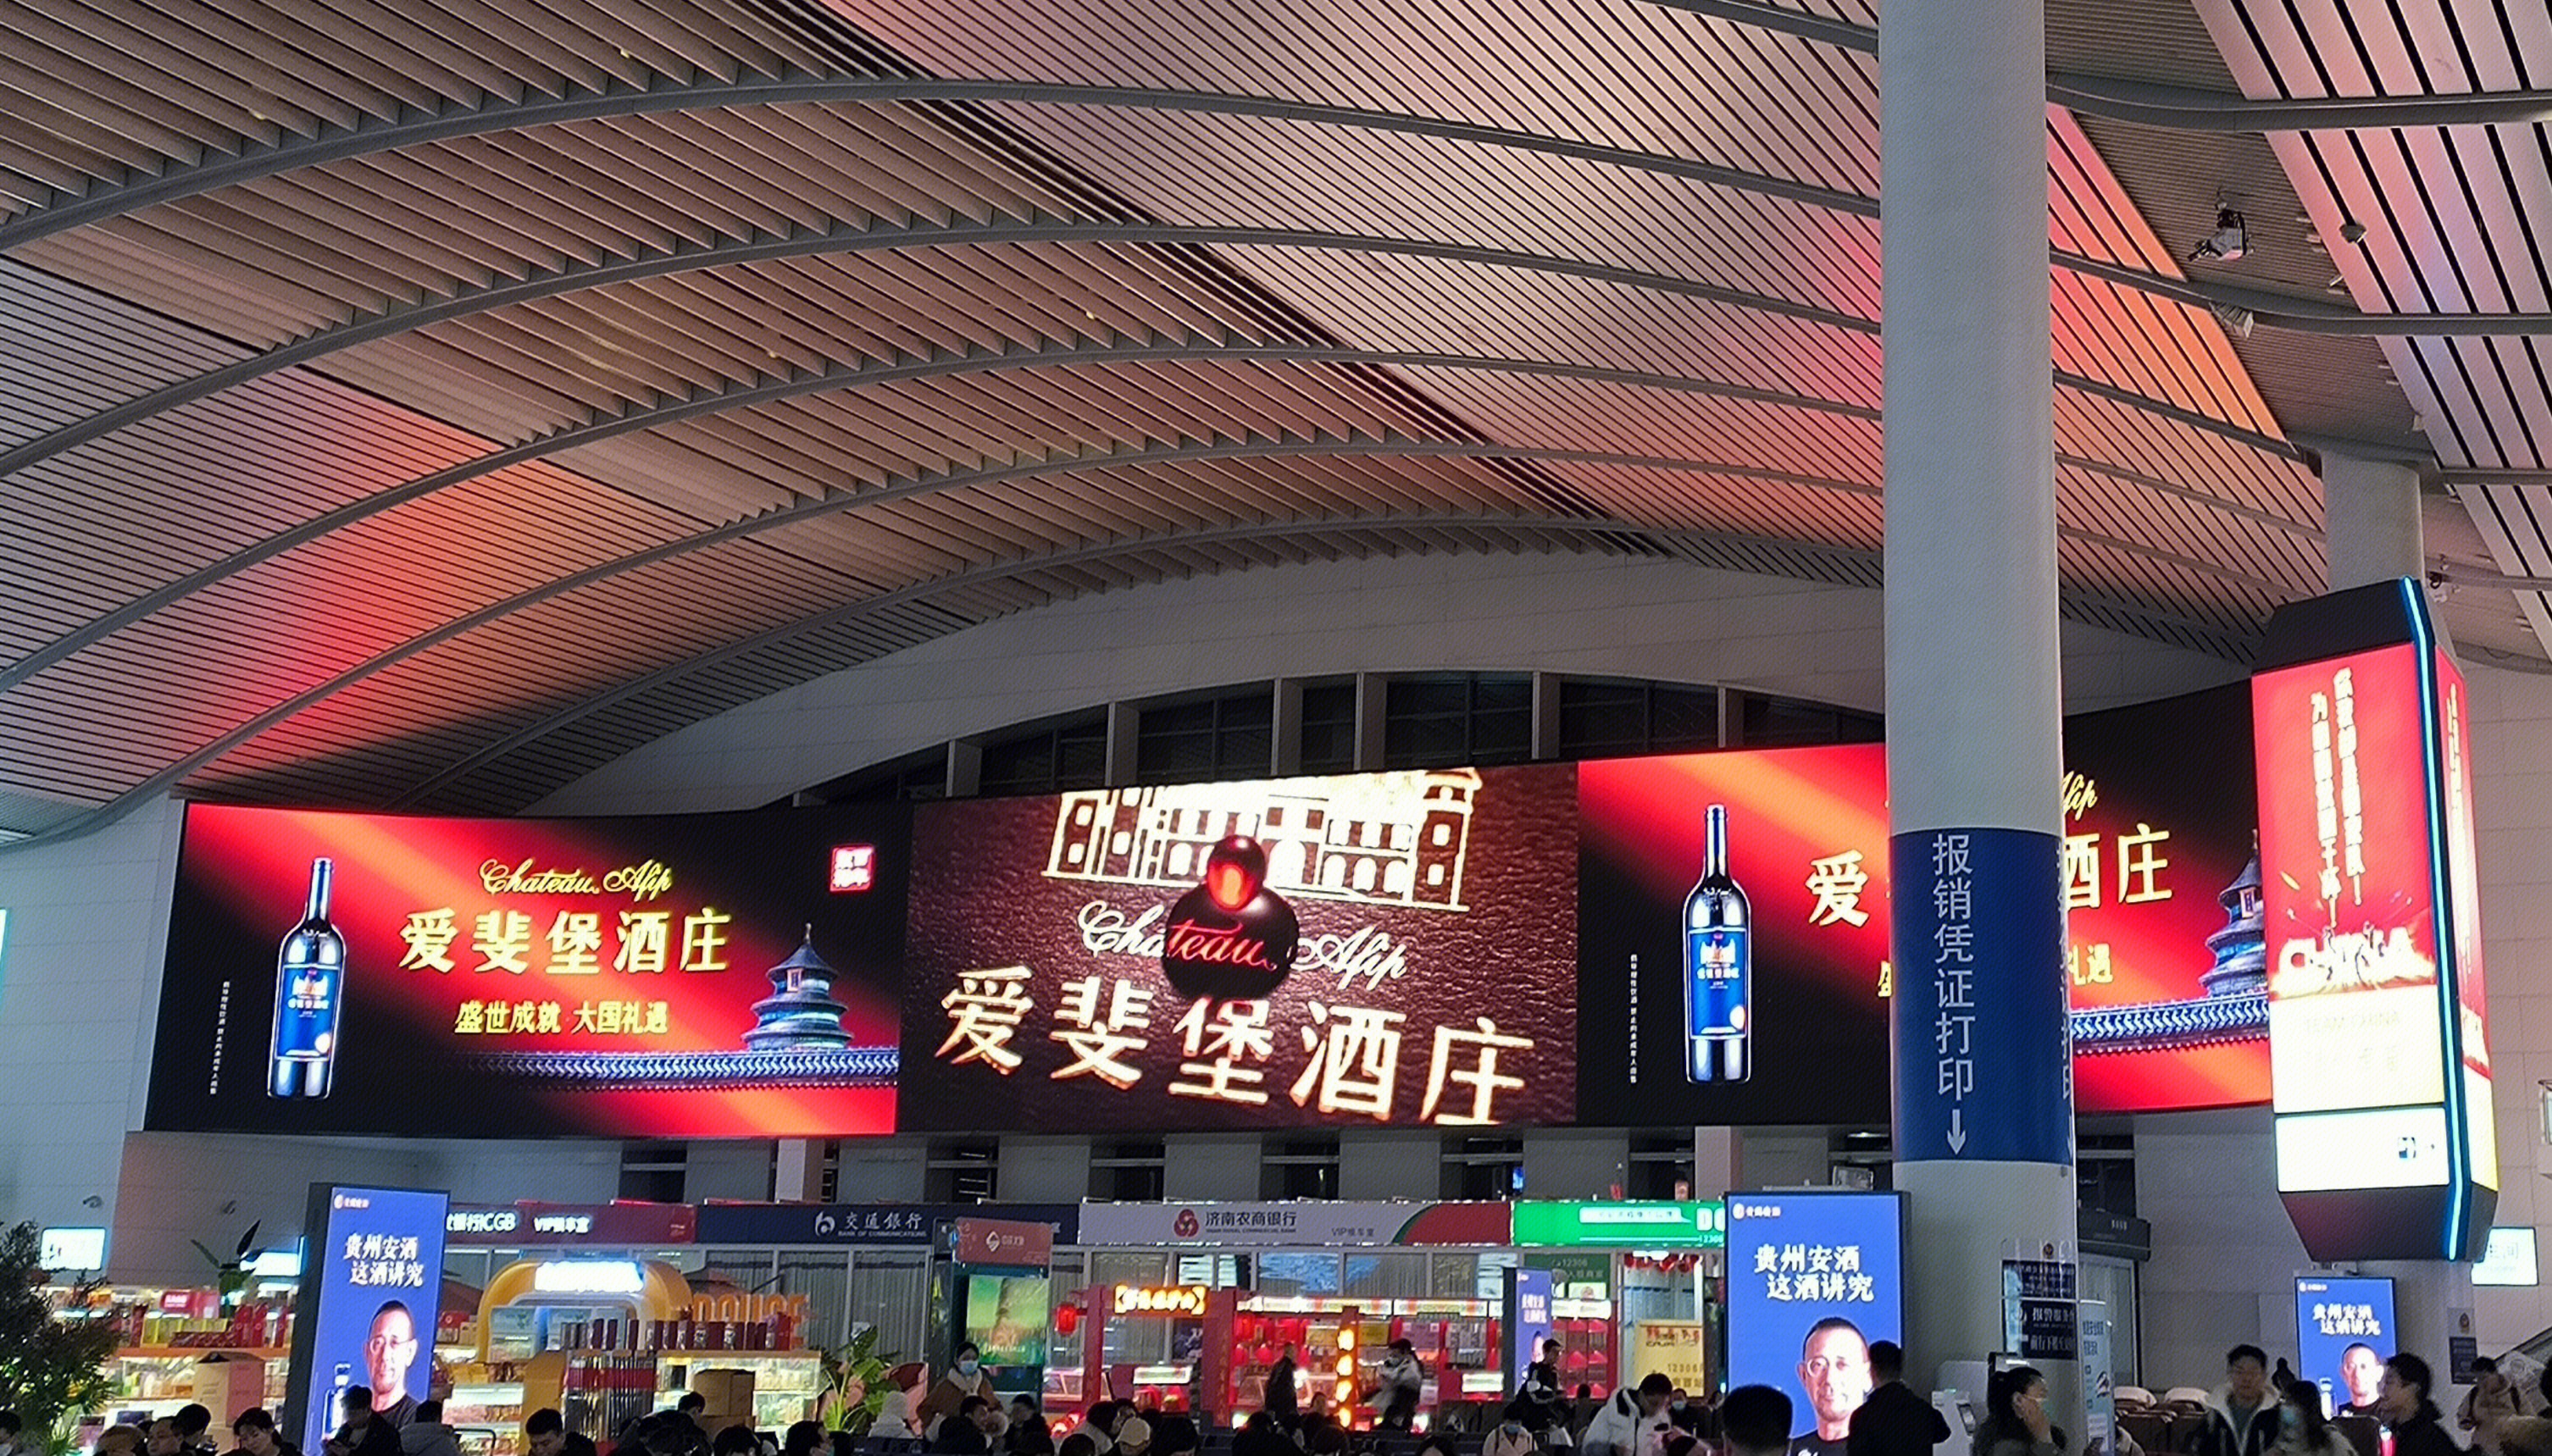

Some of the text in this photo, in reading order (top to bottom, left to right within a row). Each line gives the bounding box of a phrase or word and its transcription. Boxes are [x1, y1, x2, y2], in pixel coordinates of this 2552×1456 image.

[480, 858, 599, 895] Chateau
[399, 906, 731, 975] 爱斐堡酒庄
[1078, 900, 1278, 973] Chateau
[1932, 833, 1976, 1101] 报销凭证打印
[454, 1000, 669, 1034] 盛世成就 大国礼遇
[935, 964, 1535, 1127] 爱斐堡酒庄
[1206, 1211, 1297, 1226] 济南农商银行
[343, 1232, 419, 1261] 贵州安酒
[1754, 1243, 1860, 1273] 贵州安酒
[349, 1260, 424, 1287] 这酒讲究
[1767, 1272, 1875, 1303] 这酒讲究
